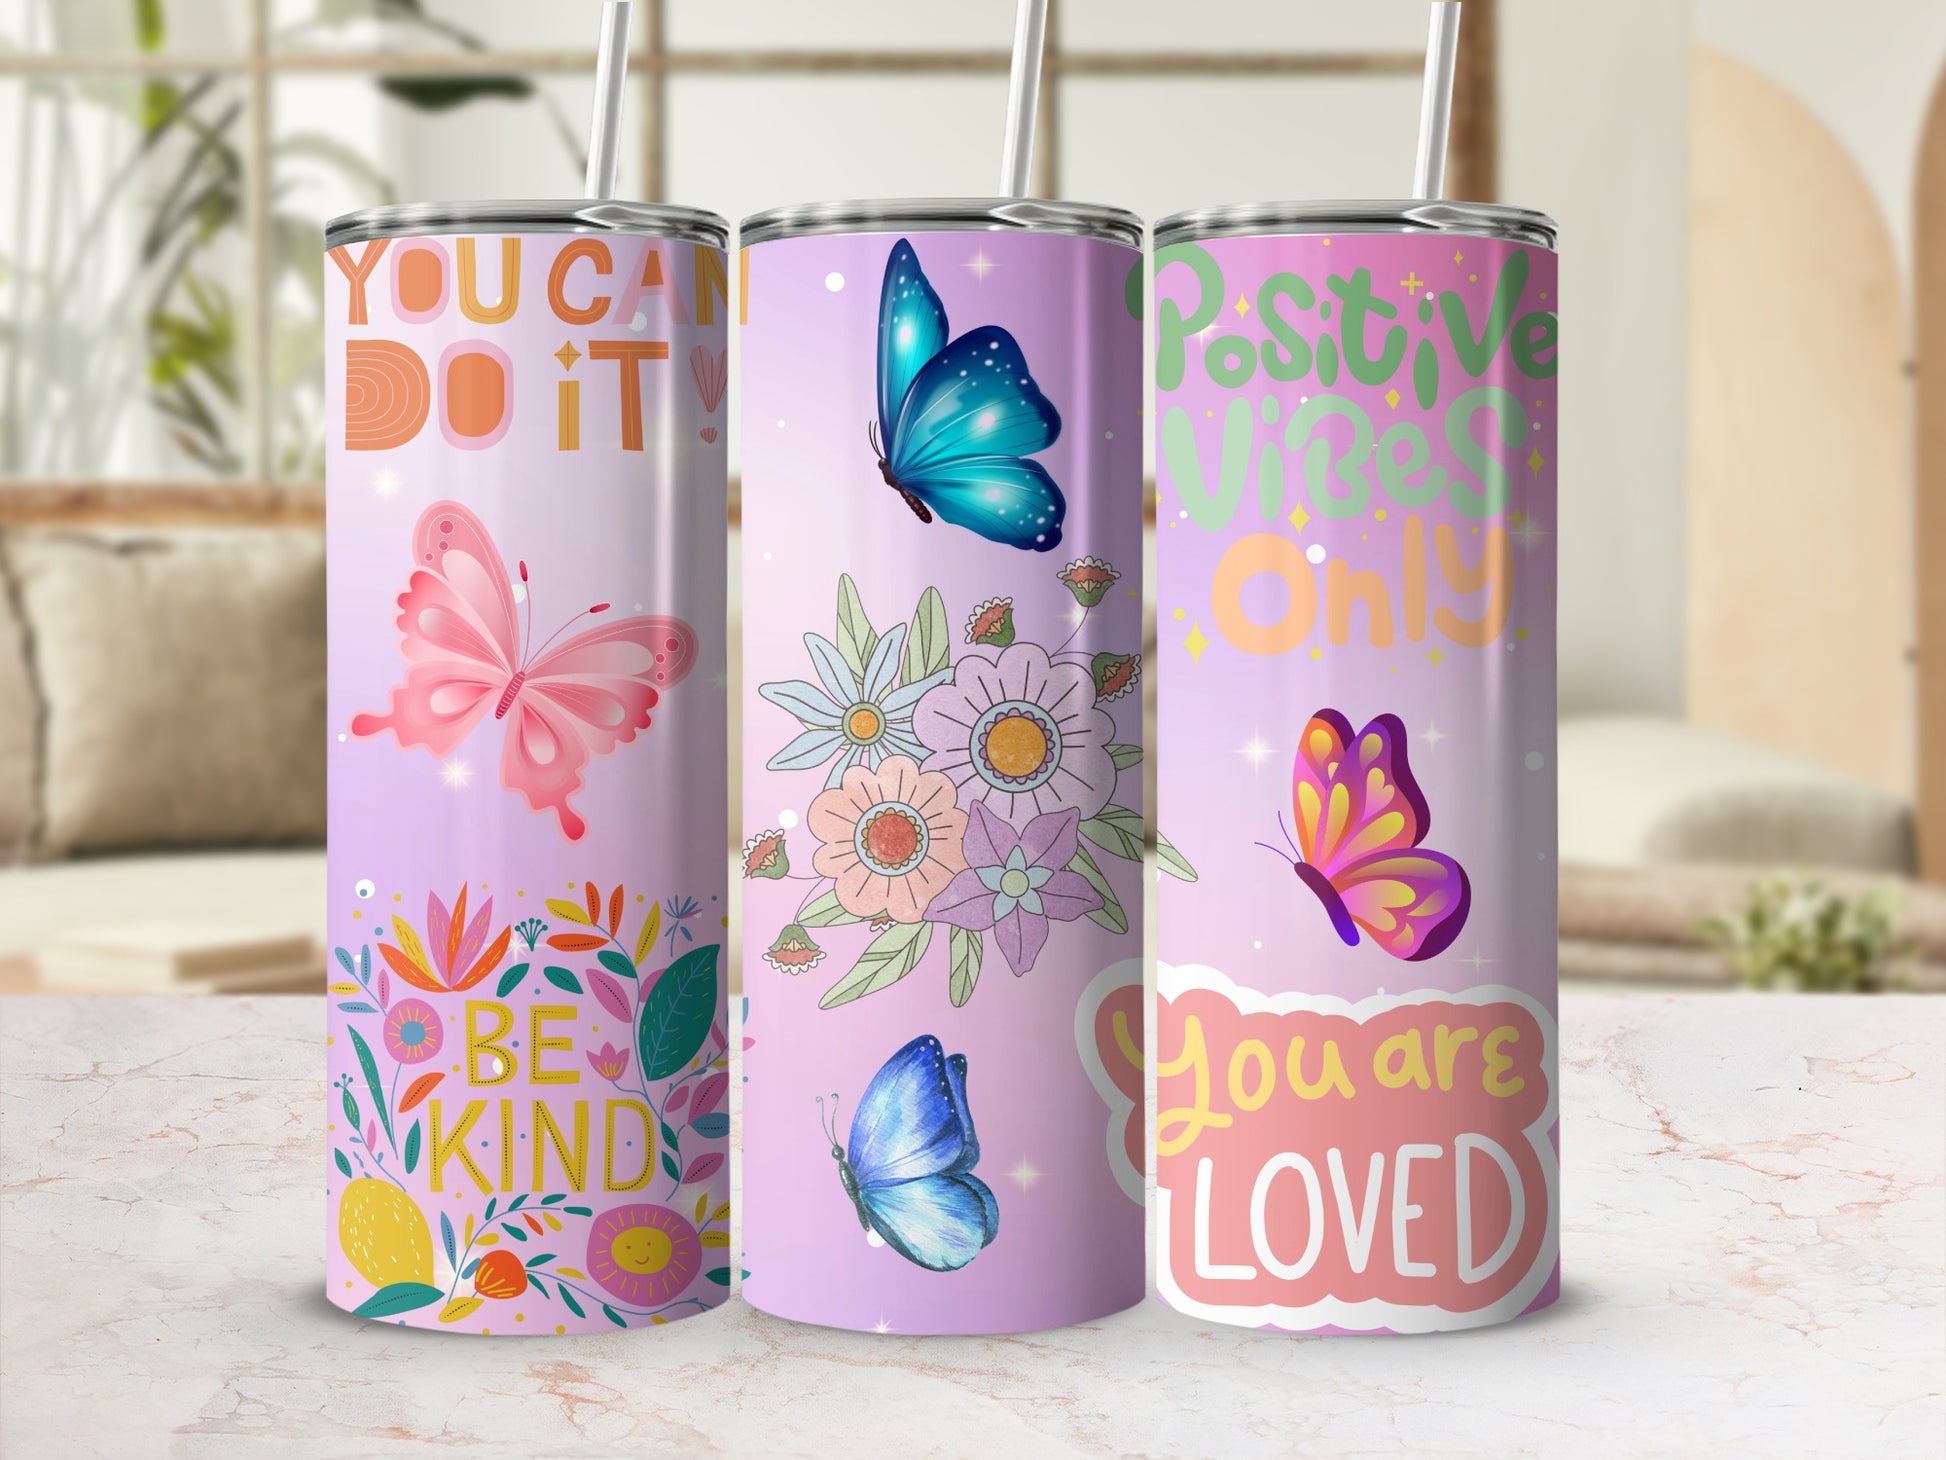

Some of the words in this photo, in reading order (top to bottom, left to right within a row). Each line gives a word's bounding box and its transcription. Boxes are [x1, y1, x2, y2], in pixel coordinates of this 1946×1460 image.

[327, 237, 521, 325] YOU
[547, 238, 728, 326] CAN
[345, 339, 514, 451] DO
[1211, 514, 1514, 656] Only
[464, 999, 581, 1087] BE
[1373, 1024, 1525, 1098] are
[428, 1098, 656, 1197] KIND
[1195, 1132, 1526, 1284] LOVED
